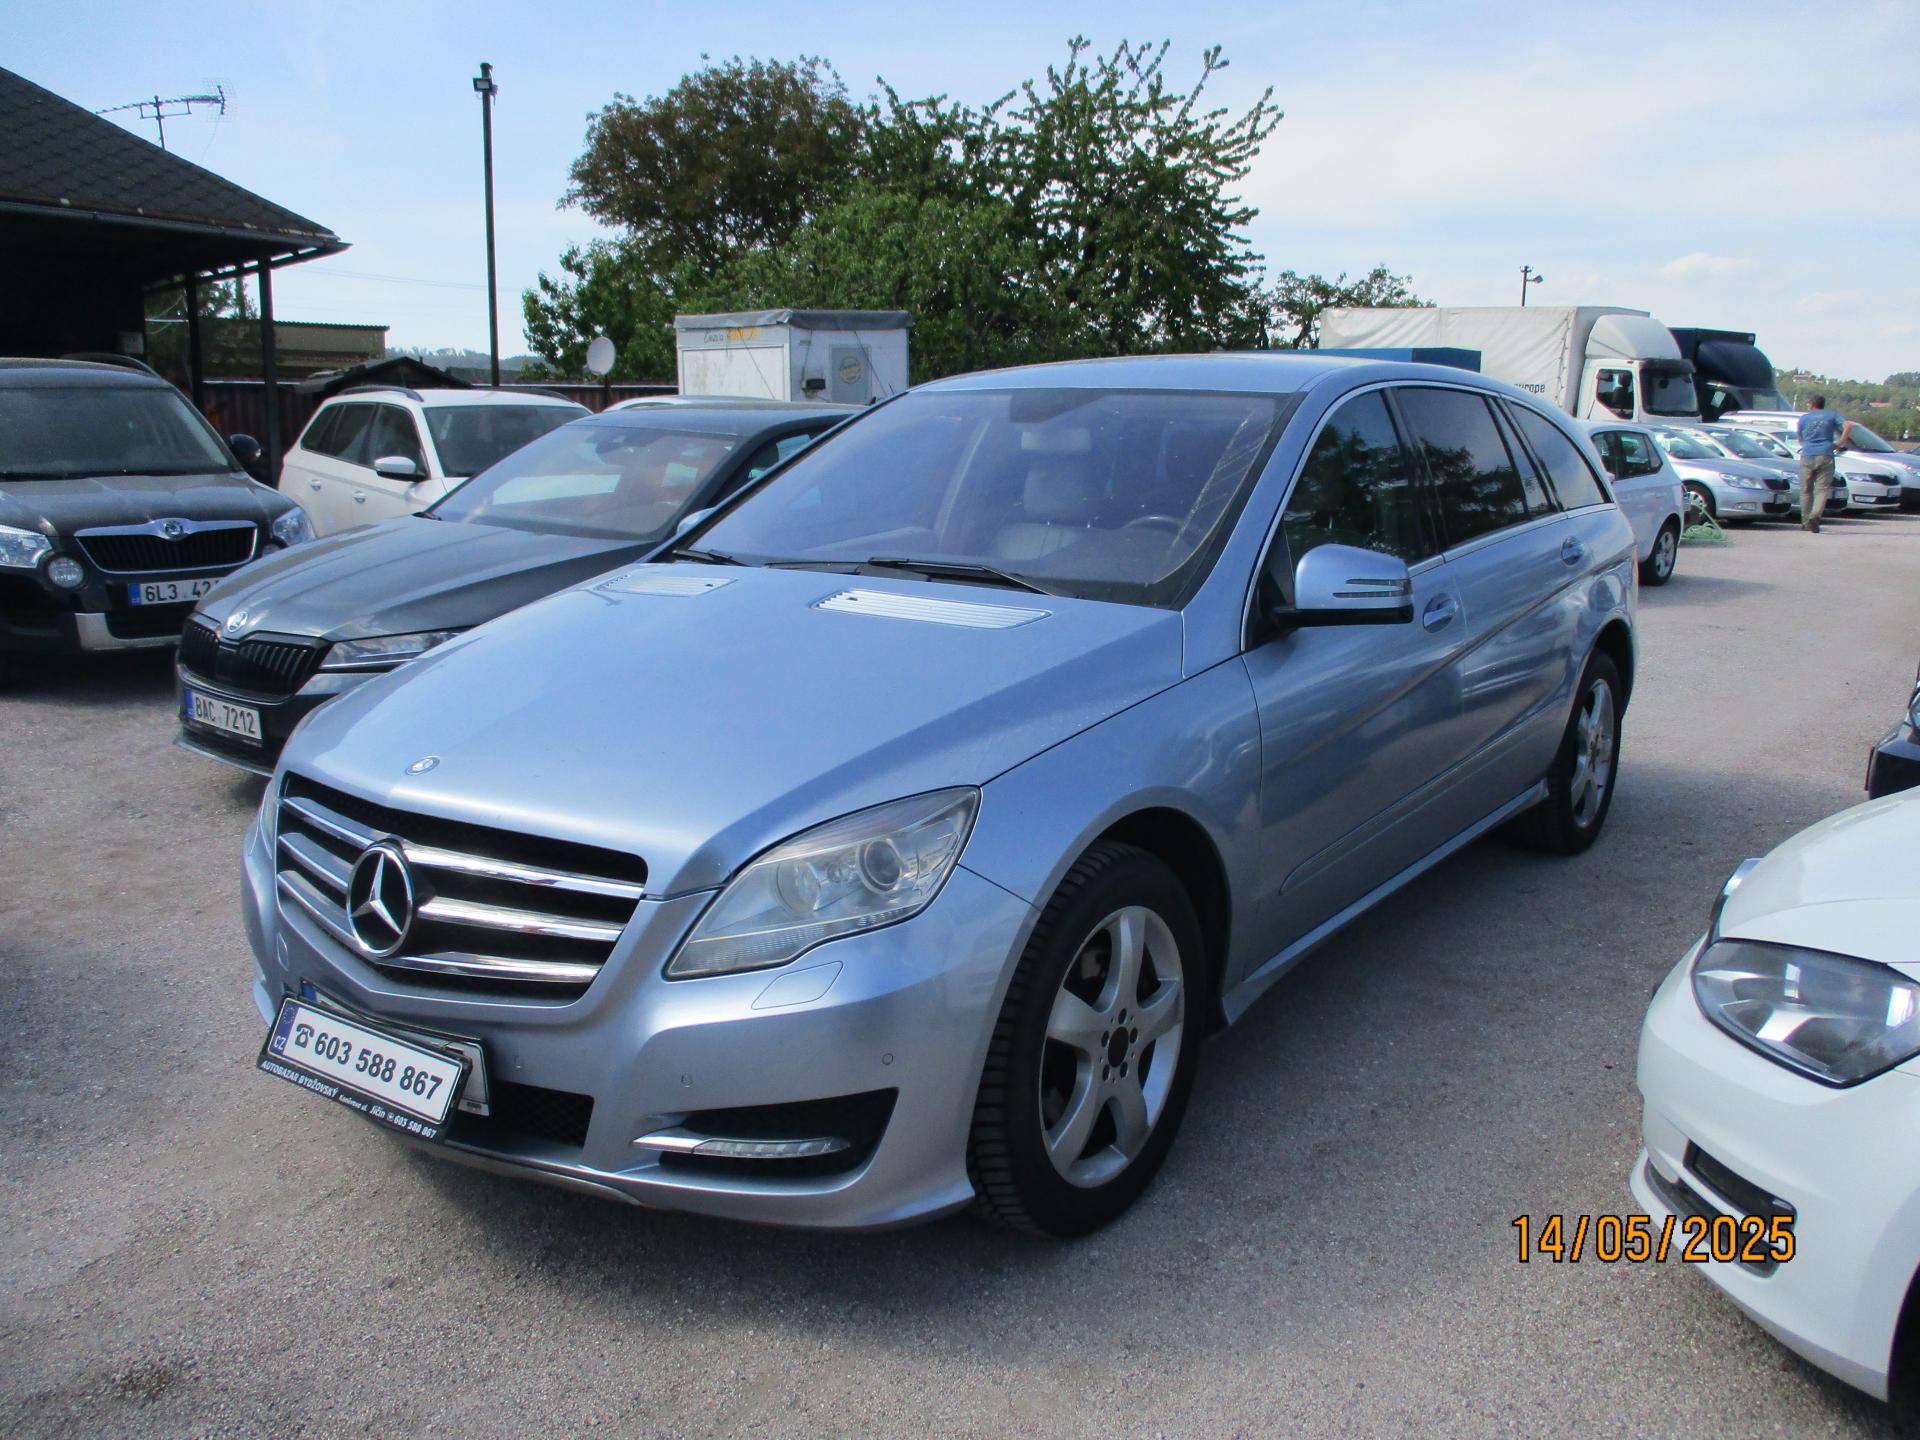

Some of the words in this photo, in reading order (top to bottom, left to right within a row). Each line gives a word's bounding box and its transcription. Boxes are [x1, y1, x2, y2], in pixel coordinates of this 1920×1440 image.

[145, 584, 178, 602] 6L3
[192, 580, 220, 598] 42
[195, 696, 216, 722] 8AC
[223, 705, 256, 735] 7212
[273, 1035, 286, 1051] CZ
[314, 1032, 352, 1065] 603
[355, 1048, 397, 1083] 588
[400, 1065, 443, 1101] 867
[261, 1060, 299, 1082] AUTOBAZAR
[298, 1074, 339, 1098] BYDŽOVSKÝ
[393, 1115, 409, 1128] 603
[407, 1120, 423, 1134] 588
[421, 1126, 438, 1139] 867
